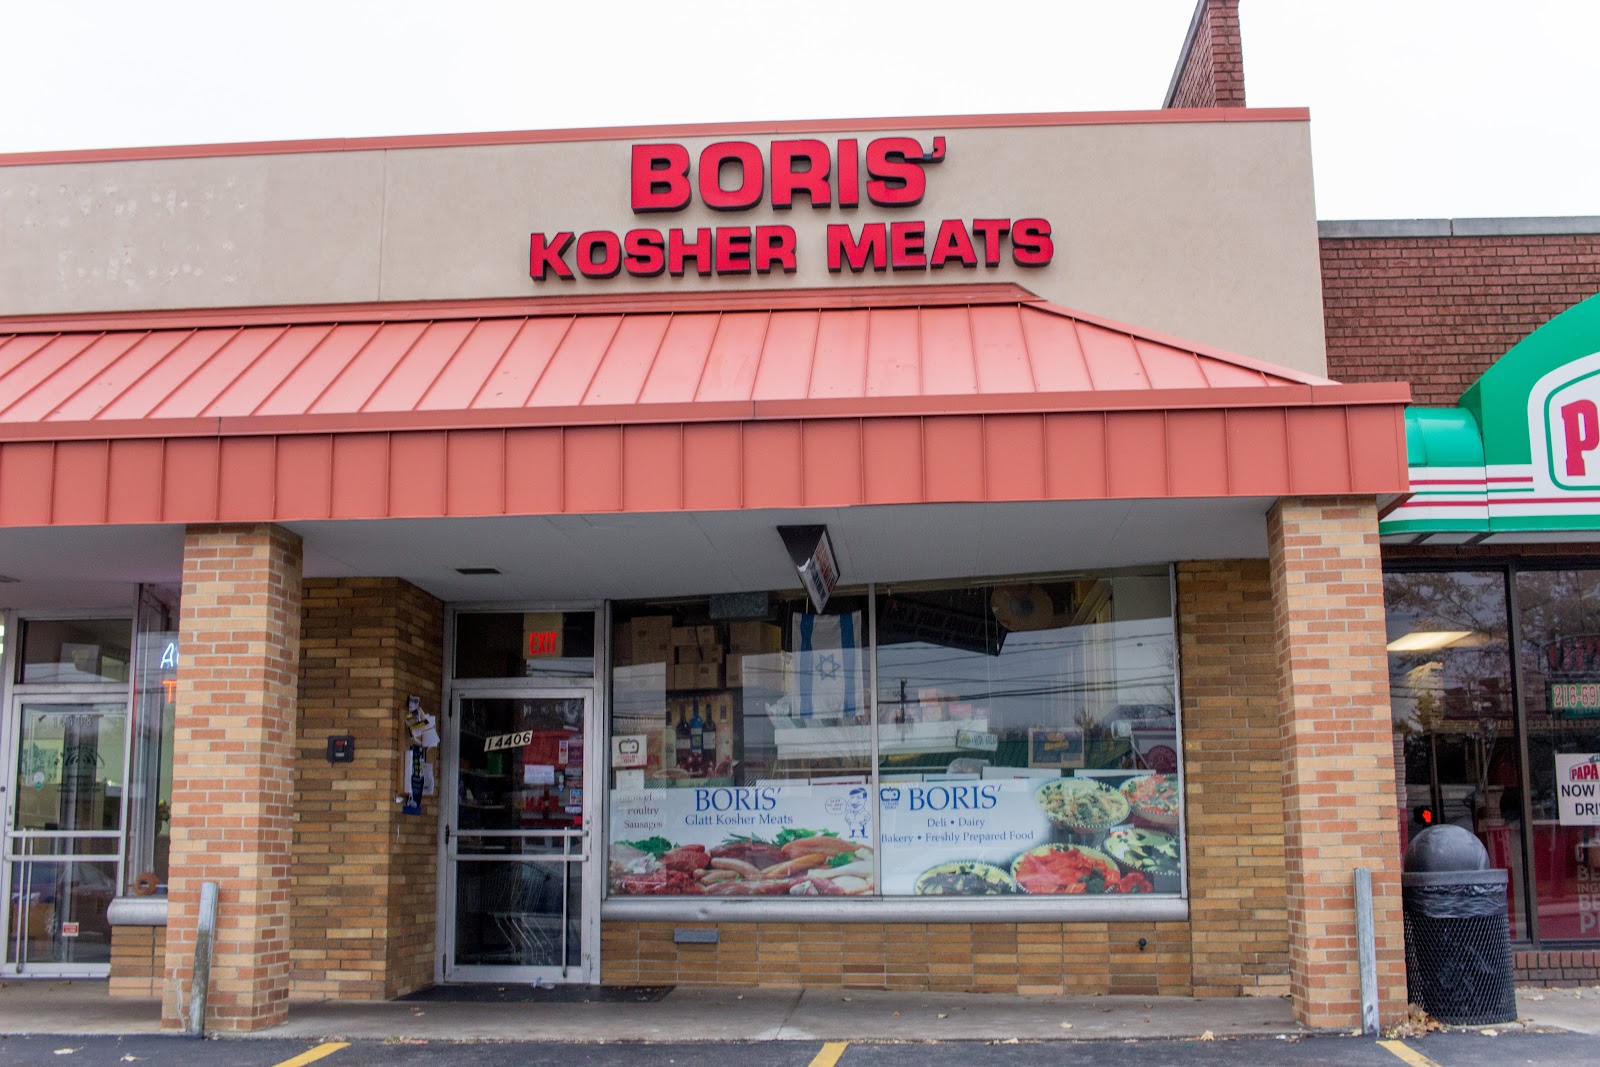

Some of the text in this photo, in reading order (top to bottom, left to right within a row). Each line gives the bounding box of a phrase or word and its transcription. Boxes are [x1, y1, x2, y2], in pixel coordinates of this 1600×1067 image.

[630, 136, 946, 214] BORIS'
[529, 218, 1054, 281] KOSHER MEATS
[529, 631, 557, 655] EXIT
[487, 732, 531, 750] 14406
[1571, 763, 1600, 780] PAPA
[695, 786, 781, 812] BORIS'
[908, 784, 1002, 811] BORIS'
[1561, 784, 1595, 797] NOW
[624, 819, 663, 831] Sausages
[685, 813, 794, 826] Glatt Kosher Meats
[927, 817, 985, 829] Deli Dairy
[881, 830, 1034, 845] Bakery Freshly Prepared Food
